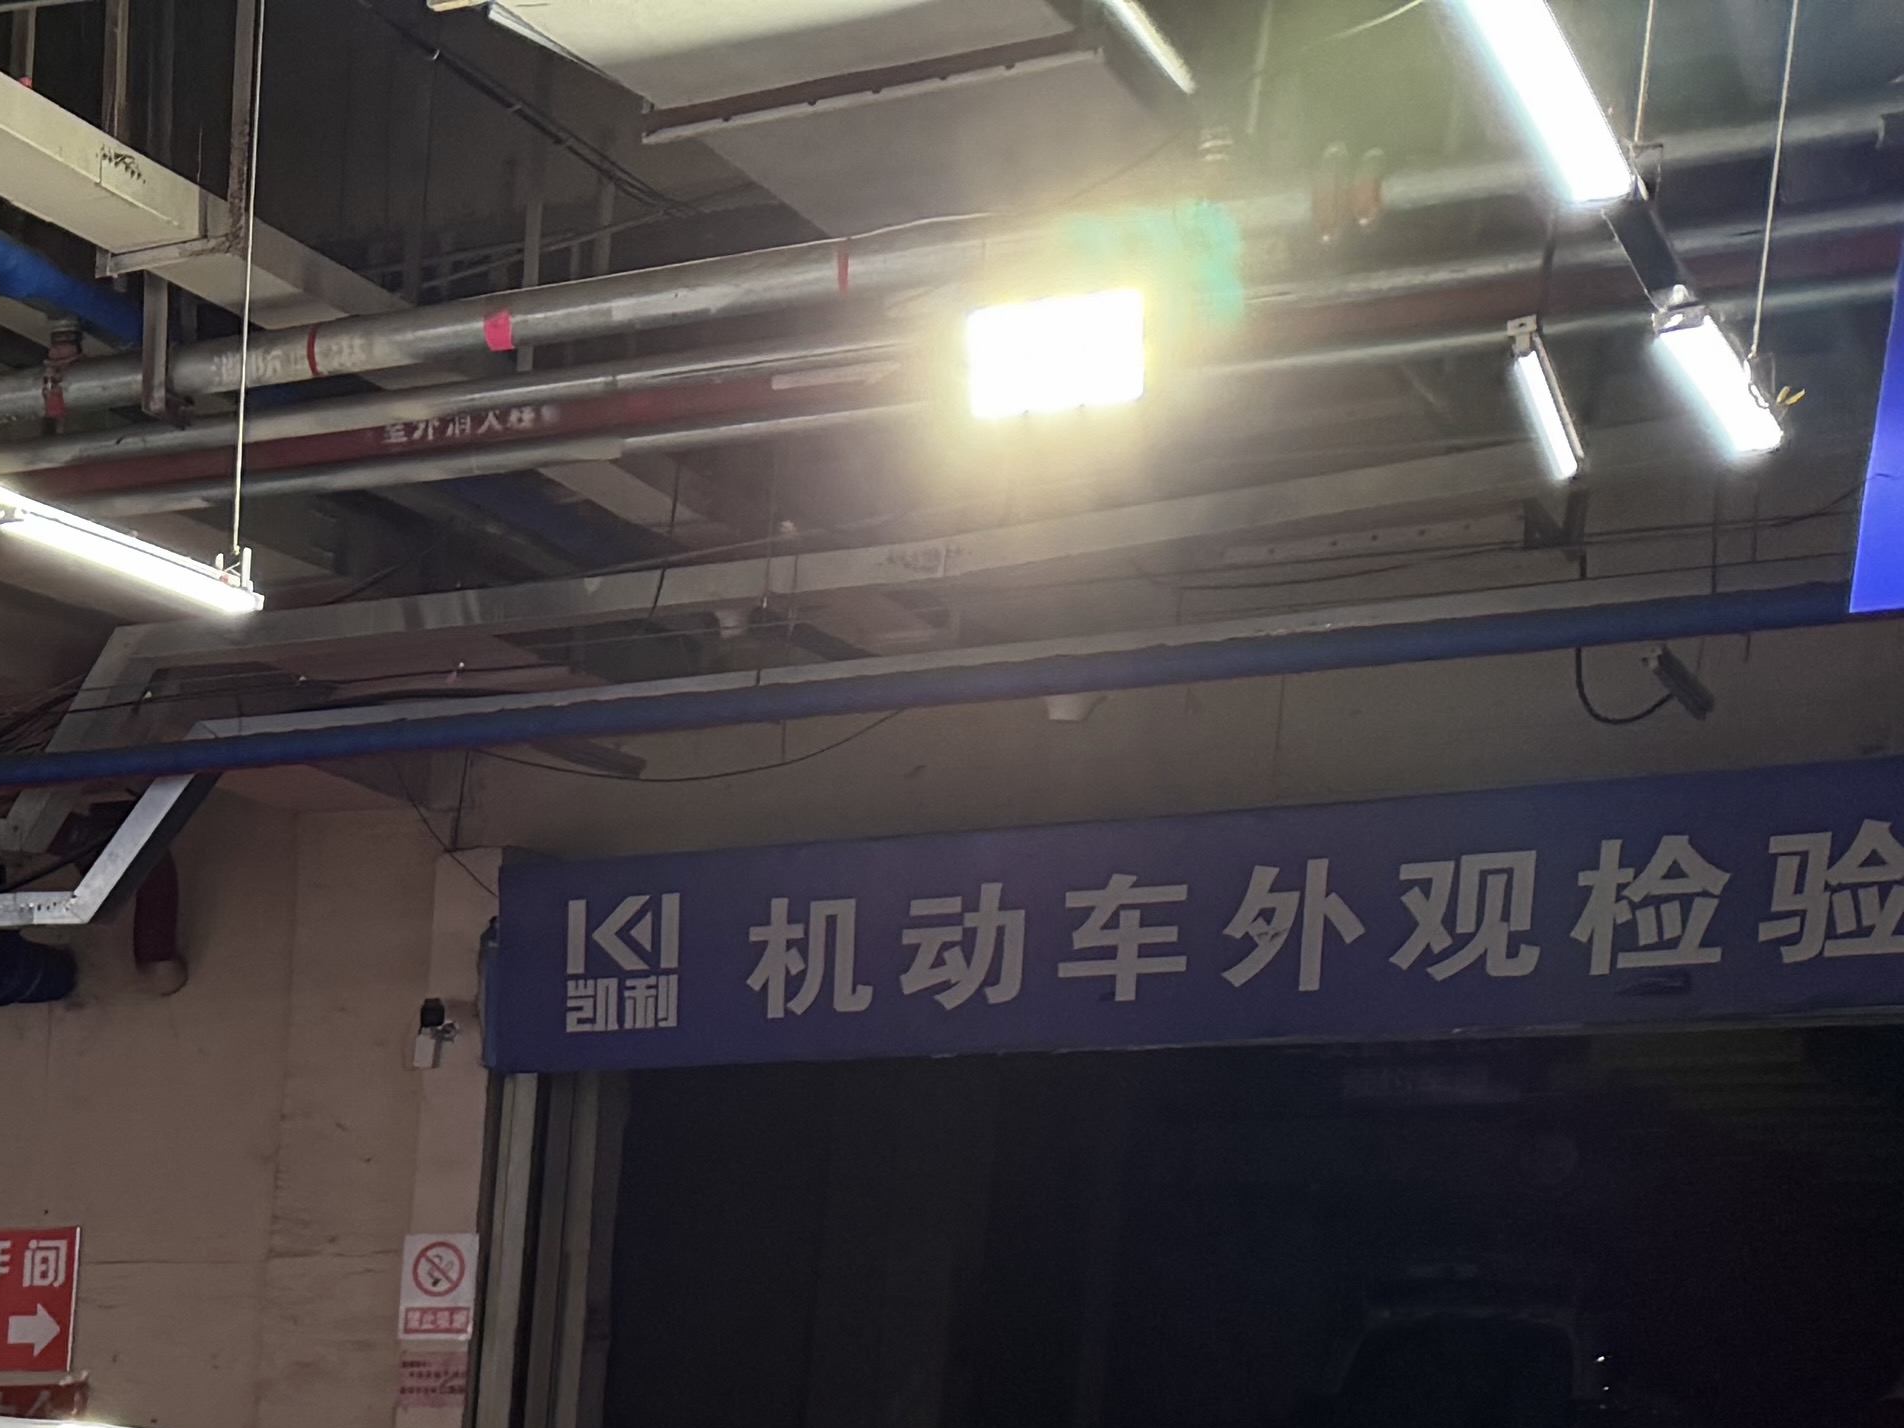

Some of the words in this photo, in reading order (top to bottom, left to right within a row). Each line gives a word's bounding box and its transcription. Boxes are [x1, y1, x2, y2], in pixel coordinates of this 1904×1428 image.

[745, 818, 1904, 1019] 机动车外观检验
[565, 974, 679, 1033] 凯利
